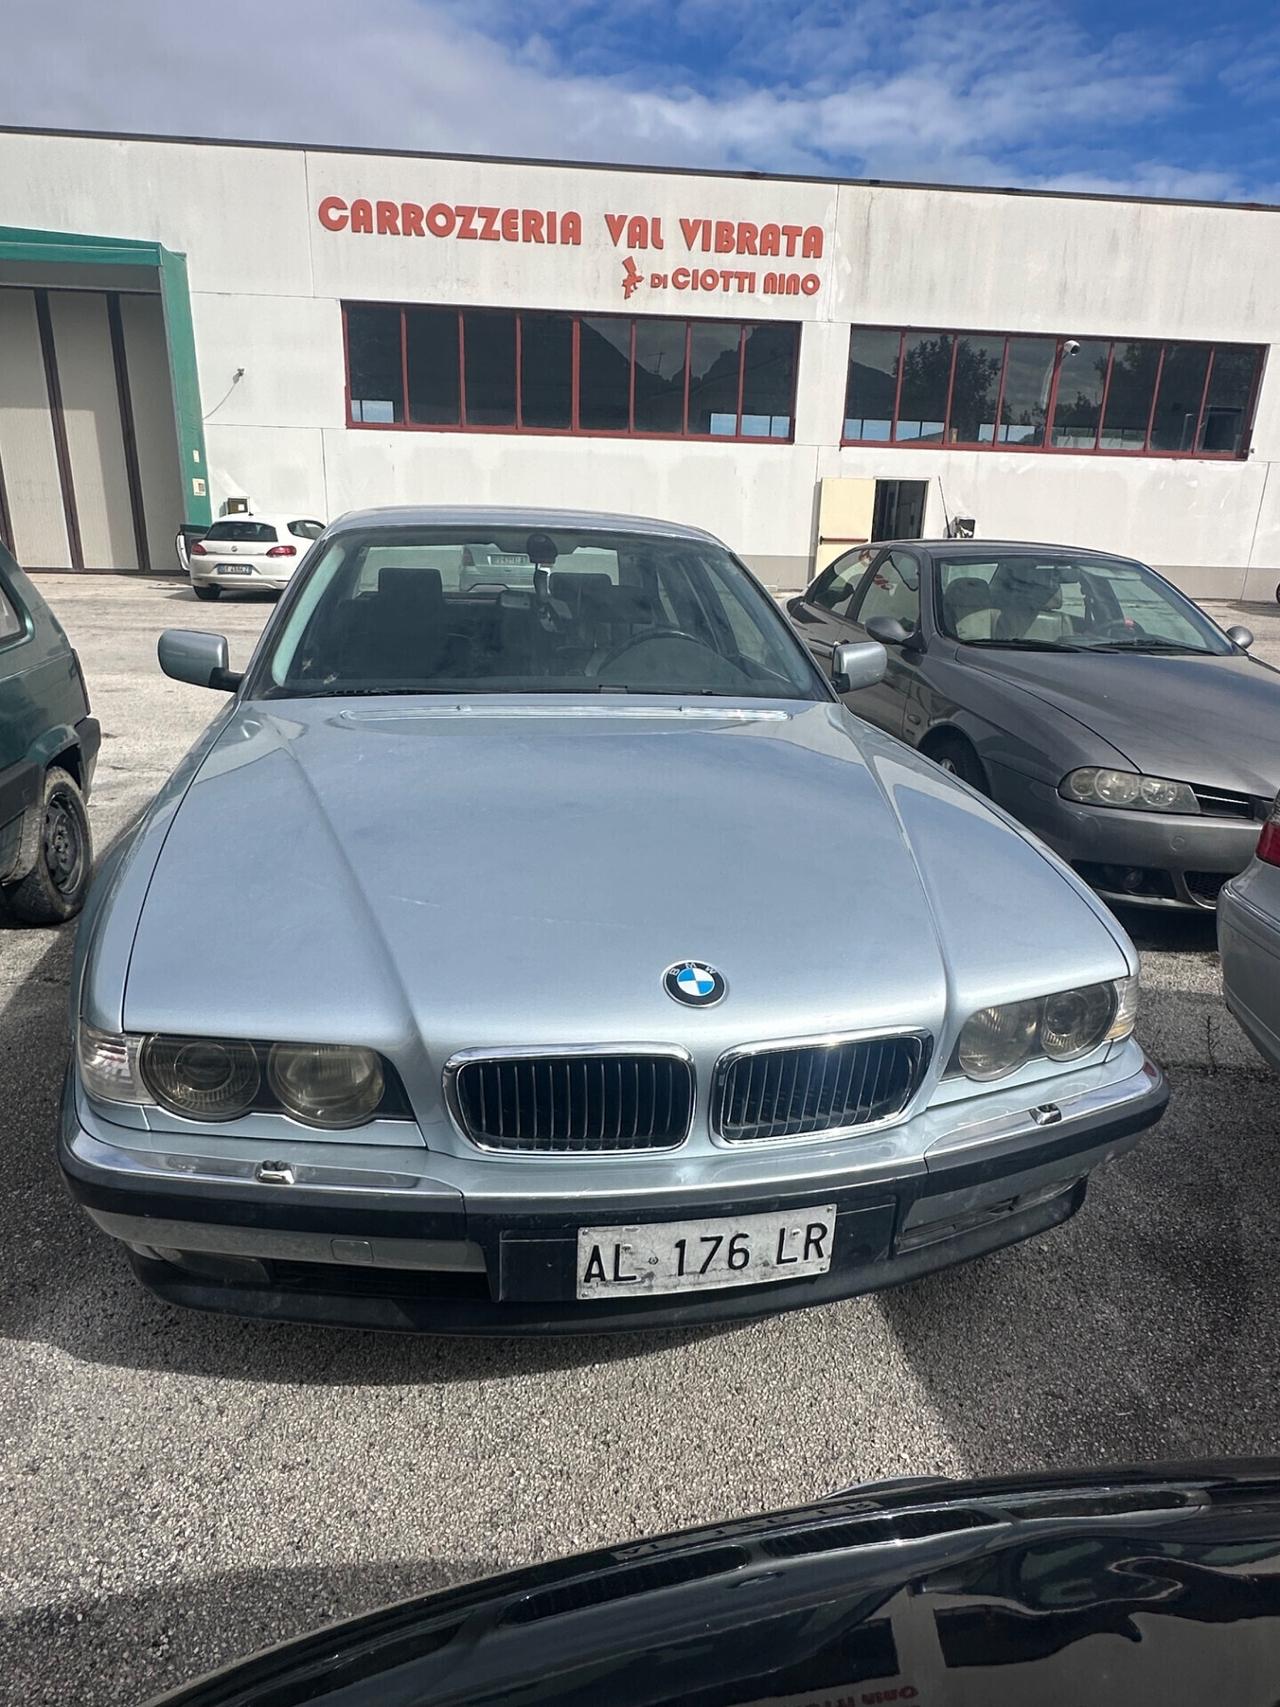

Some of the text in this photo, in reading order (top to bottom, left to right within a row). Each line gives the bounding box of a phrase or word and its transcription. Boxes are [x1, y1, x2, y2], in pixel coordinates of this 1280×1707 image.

[318, 196, 824, 259] CARROZZERIA VAL VIBRATA
[650, 267, 821, 296] DI CIOTTI NINO
[668, 962, 717, 976] BMW
[583, 1222, 828, 1284] AL 176 LR
